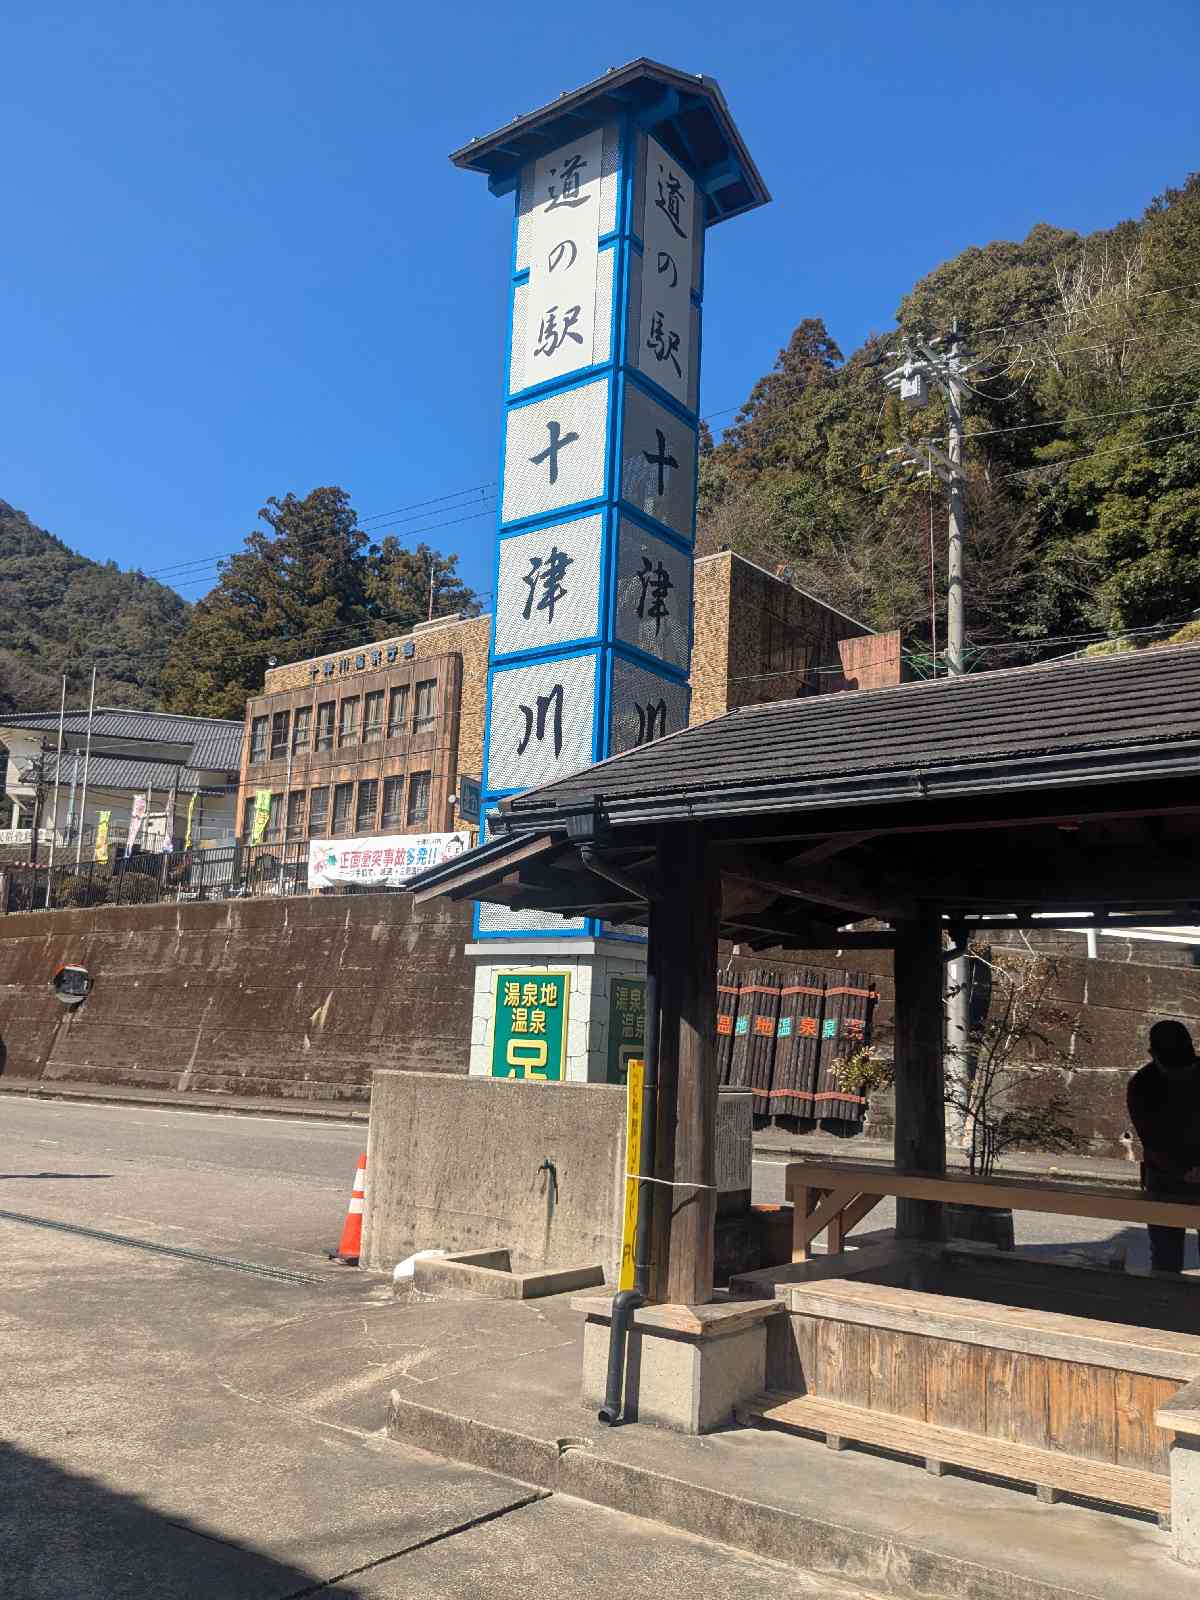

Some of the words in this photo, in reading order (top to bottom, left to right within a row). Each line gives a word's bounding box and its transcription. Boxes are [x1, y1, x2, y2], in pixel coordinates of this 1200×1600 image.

[534, 155, 592, 358] 道の駅
[647, 165, 688, 379] 道の駅
[518, 420, 580, 760] 十津川
[503, 982, 558, 1008] 湯泉地
[511, 1008, 547, 1034] 温泉
